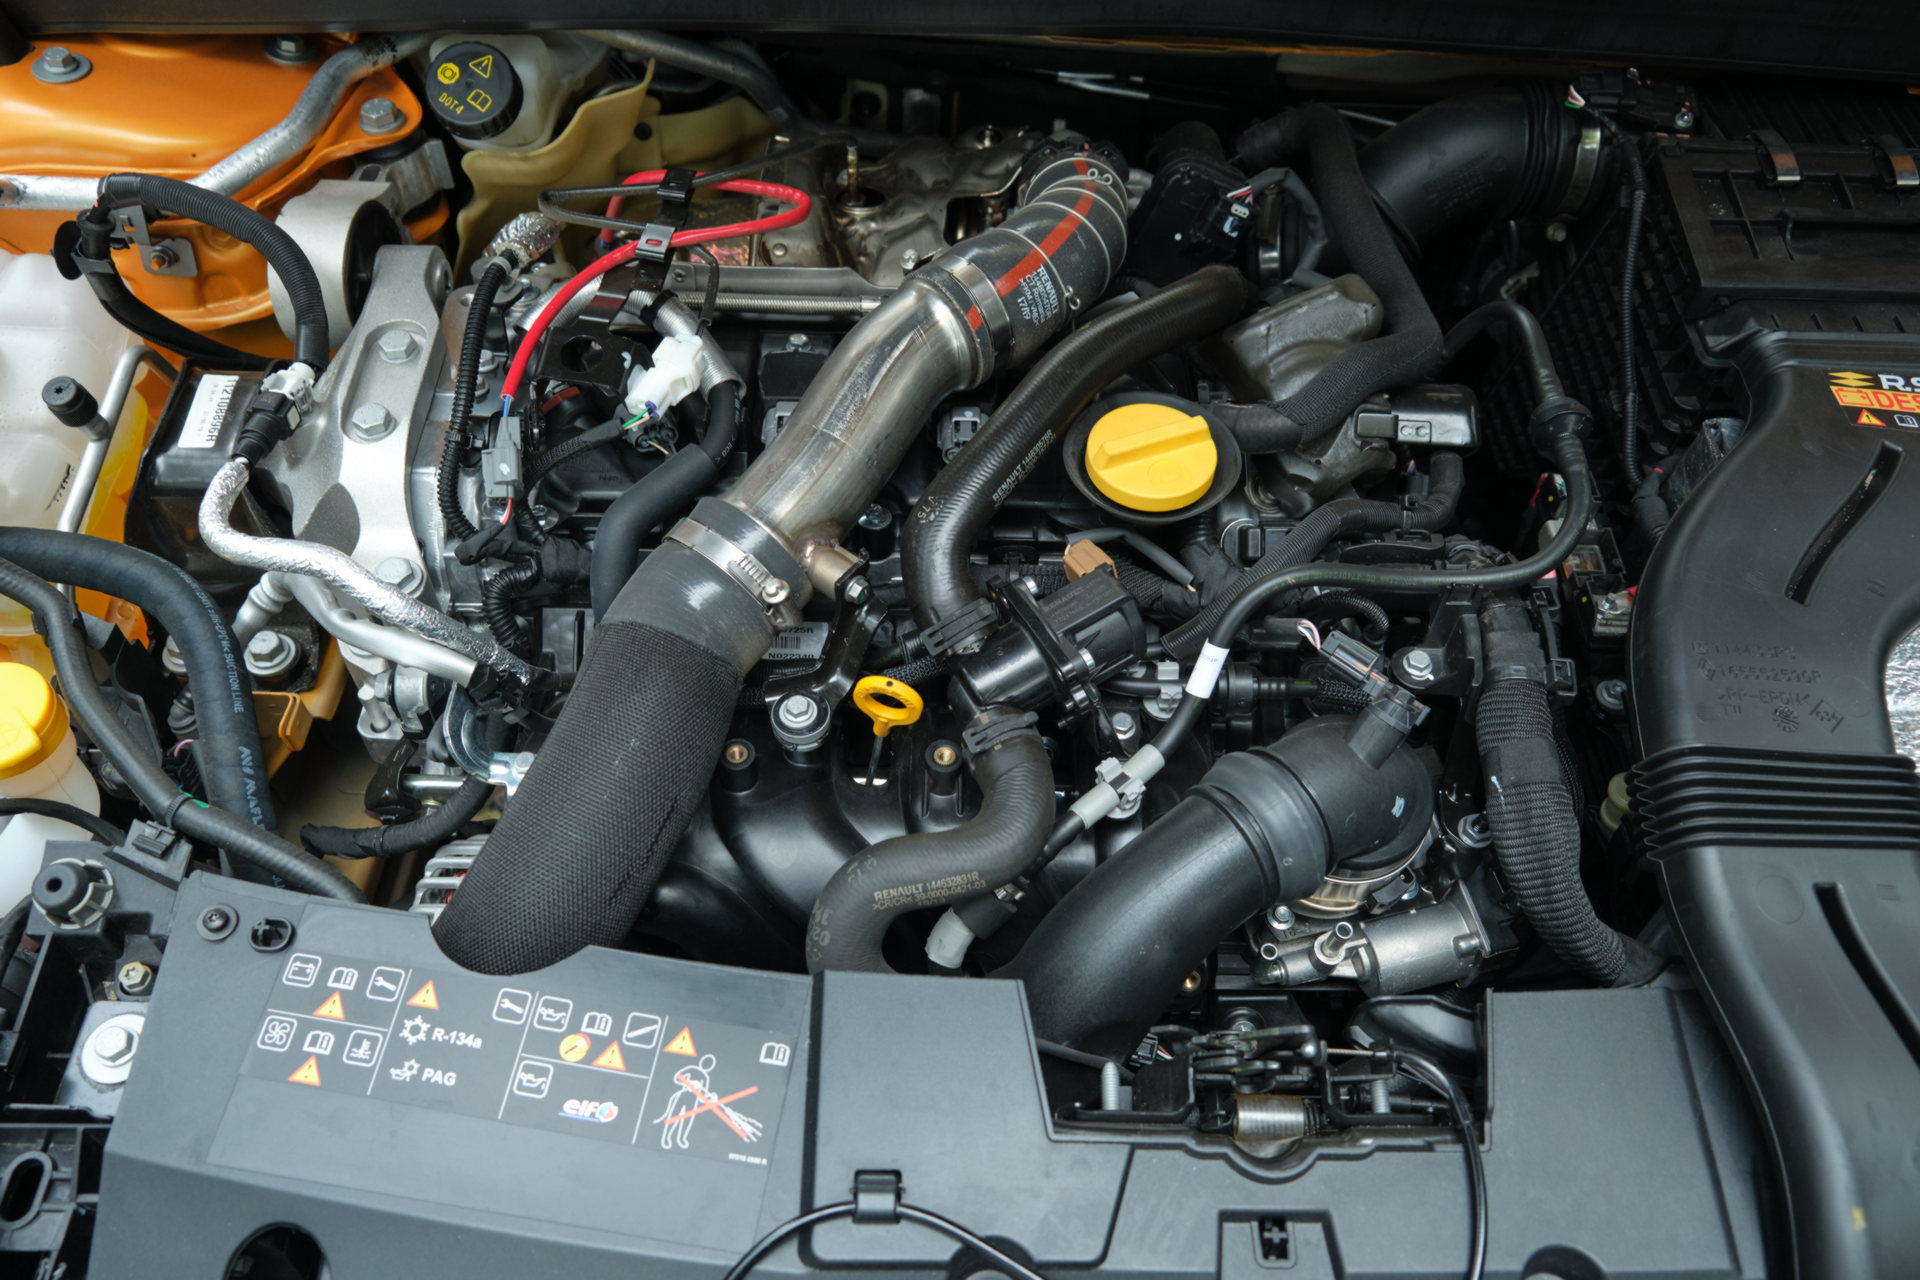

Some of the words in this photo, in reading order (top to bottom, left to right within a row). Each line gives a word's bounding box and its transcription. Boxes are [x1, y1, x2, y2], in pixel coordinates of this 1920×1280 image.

[1037, 264, 1059, 313] RENAULT
[992, 464, 1022, 501] RENAULT
[224, 653, 241, 691] SUCTION
[231, 692, 245, 713] LINE
[873, 883, 923, 901] RENAULT
[431, 1027, 482, 1049] R-134a
[421, 1067, 457, 1086] PAG
